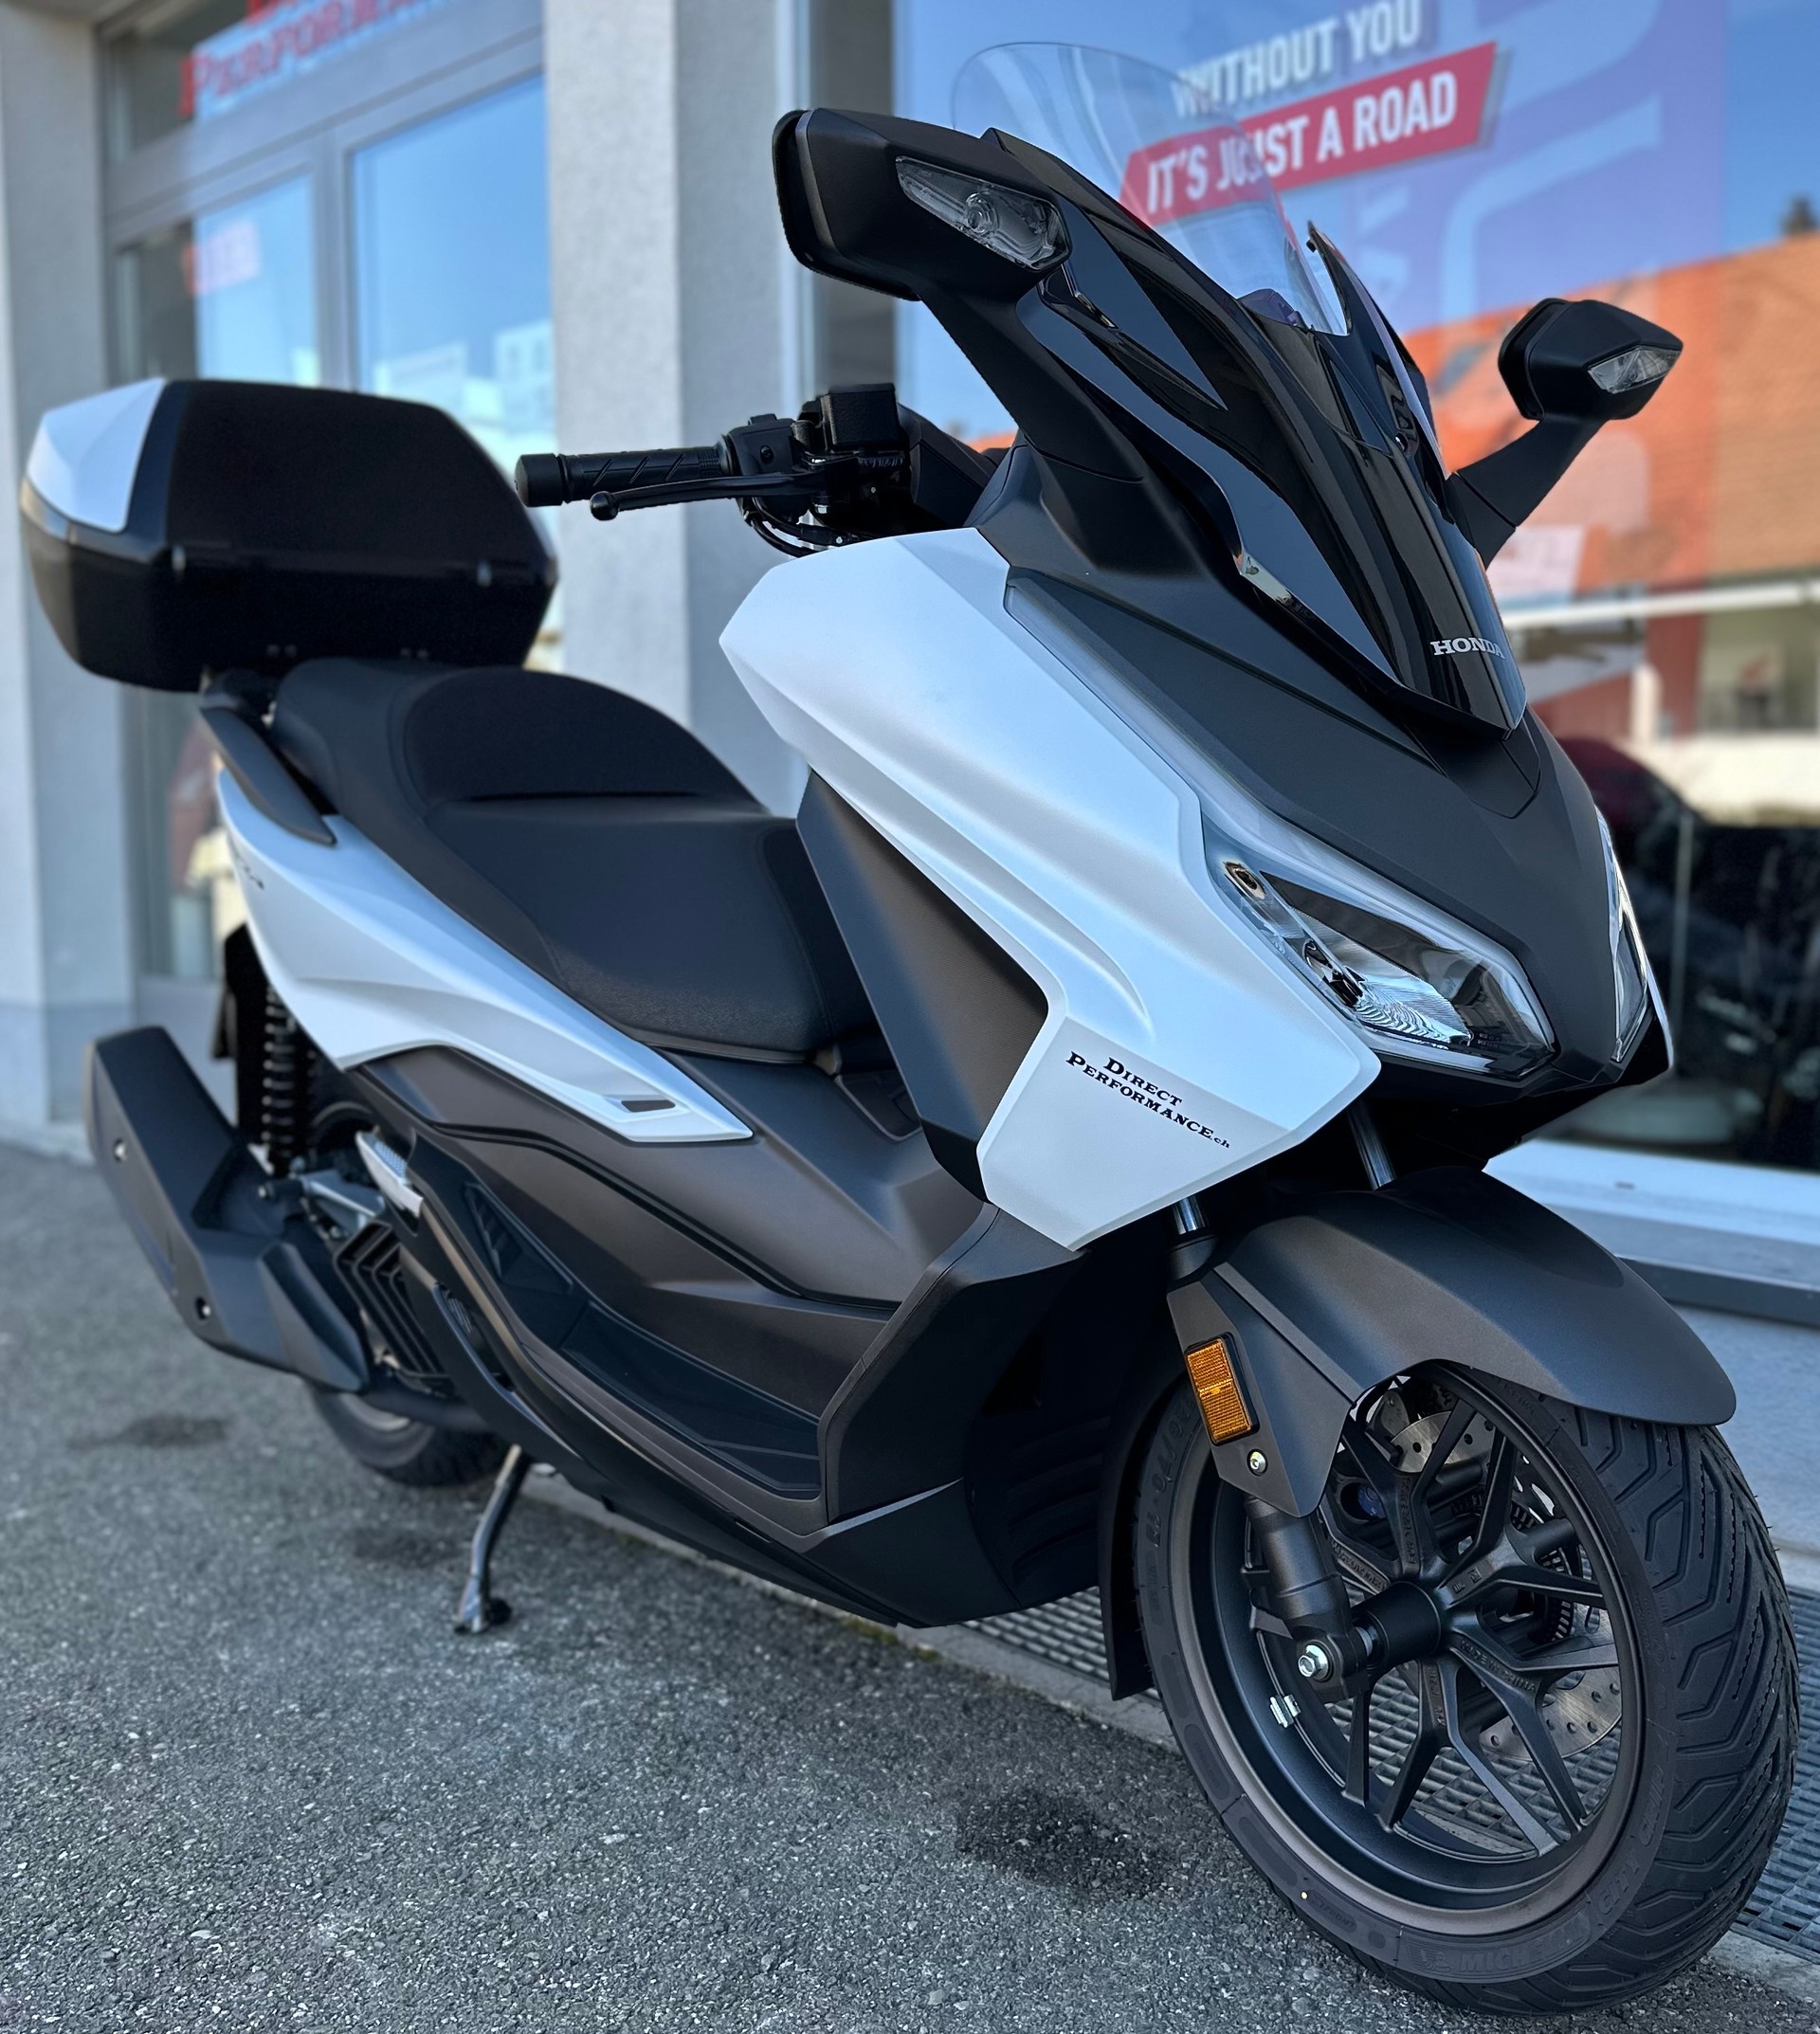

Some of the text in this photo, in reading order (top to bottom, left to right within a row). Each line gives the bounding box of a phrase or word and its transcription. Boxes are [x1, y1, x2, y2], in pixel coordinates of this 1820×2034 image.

[1171, 0, 1420, 118] WITHOUT YOU
[1146, 143, 1209, 214] IT'S
[1317, 106, 1344, 162] A
[1354, 71, 1457, 151] ROAD
[1429, 637, 1505, 660] HONDA
[1103, 1056, 1183, 1107] DIRECT
